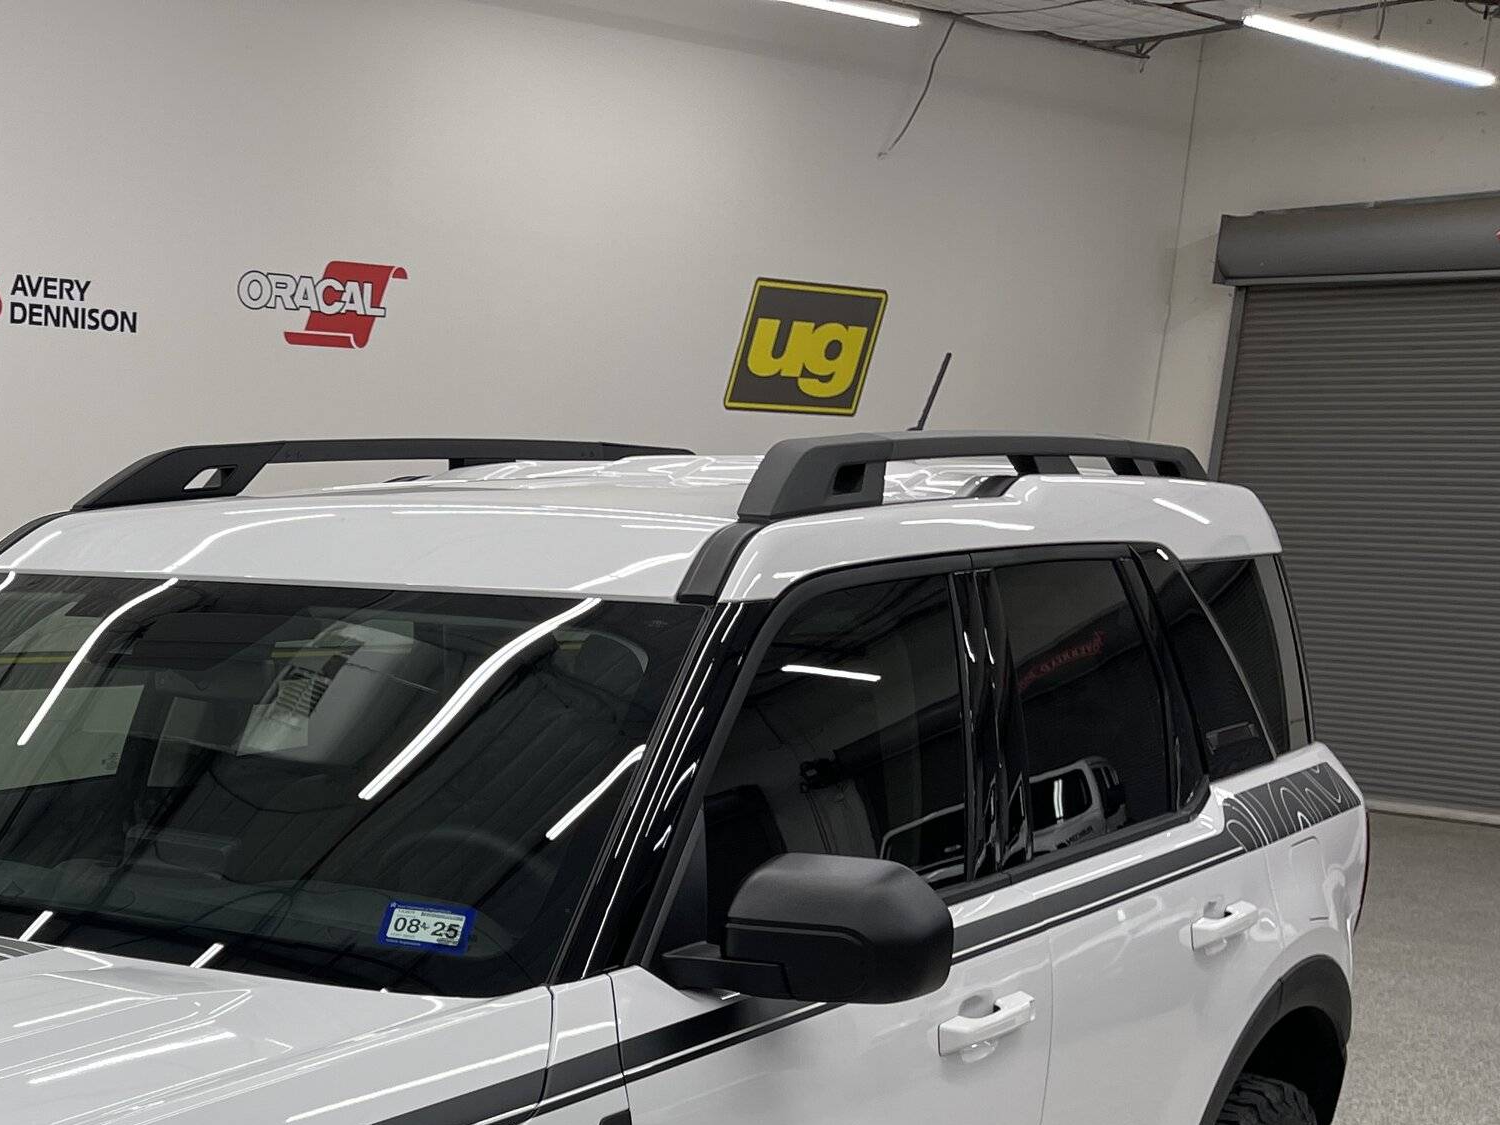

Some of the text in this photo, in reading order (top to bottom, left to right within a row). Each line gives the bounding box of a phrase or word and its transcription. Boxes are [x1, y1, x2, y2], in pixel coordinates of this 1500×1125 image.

[10, 273, 91, 302] AVERY
[237, 269, 386, 318] ORACAL
[9, 302, 137, 334] DENNISON
[747, 317, 869, 399] ug
